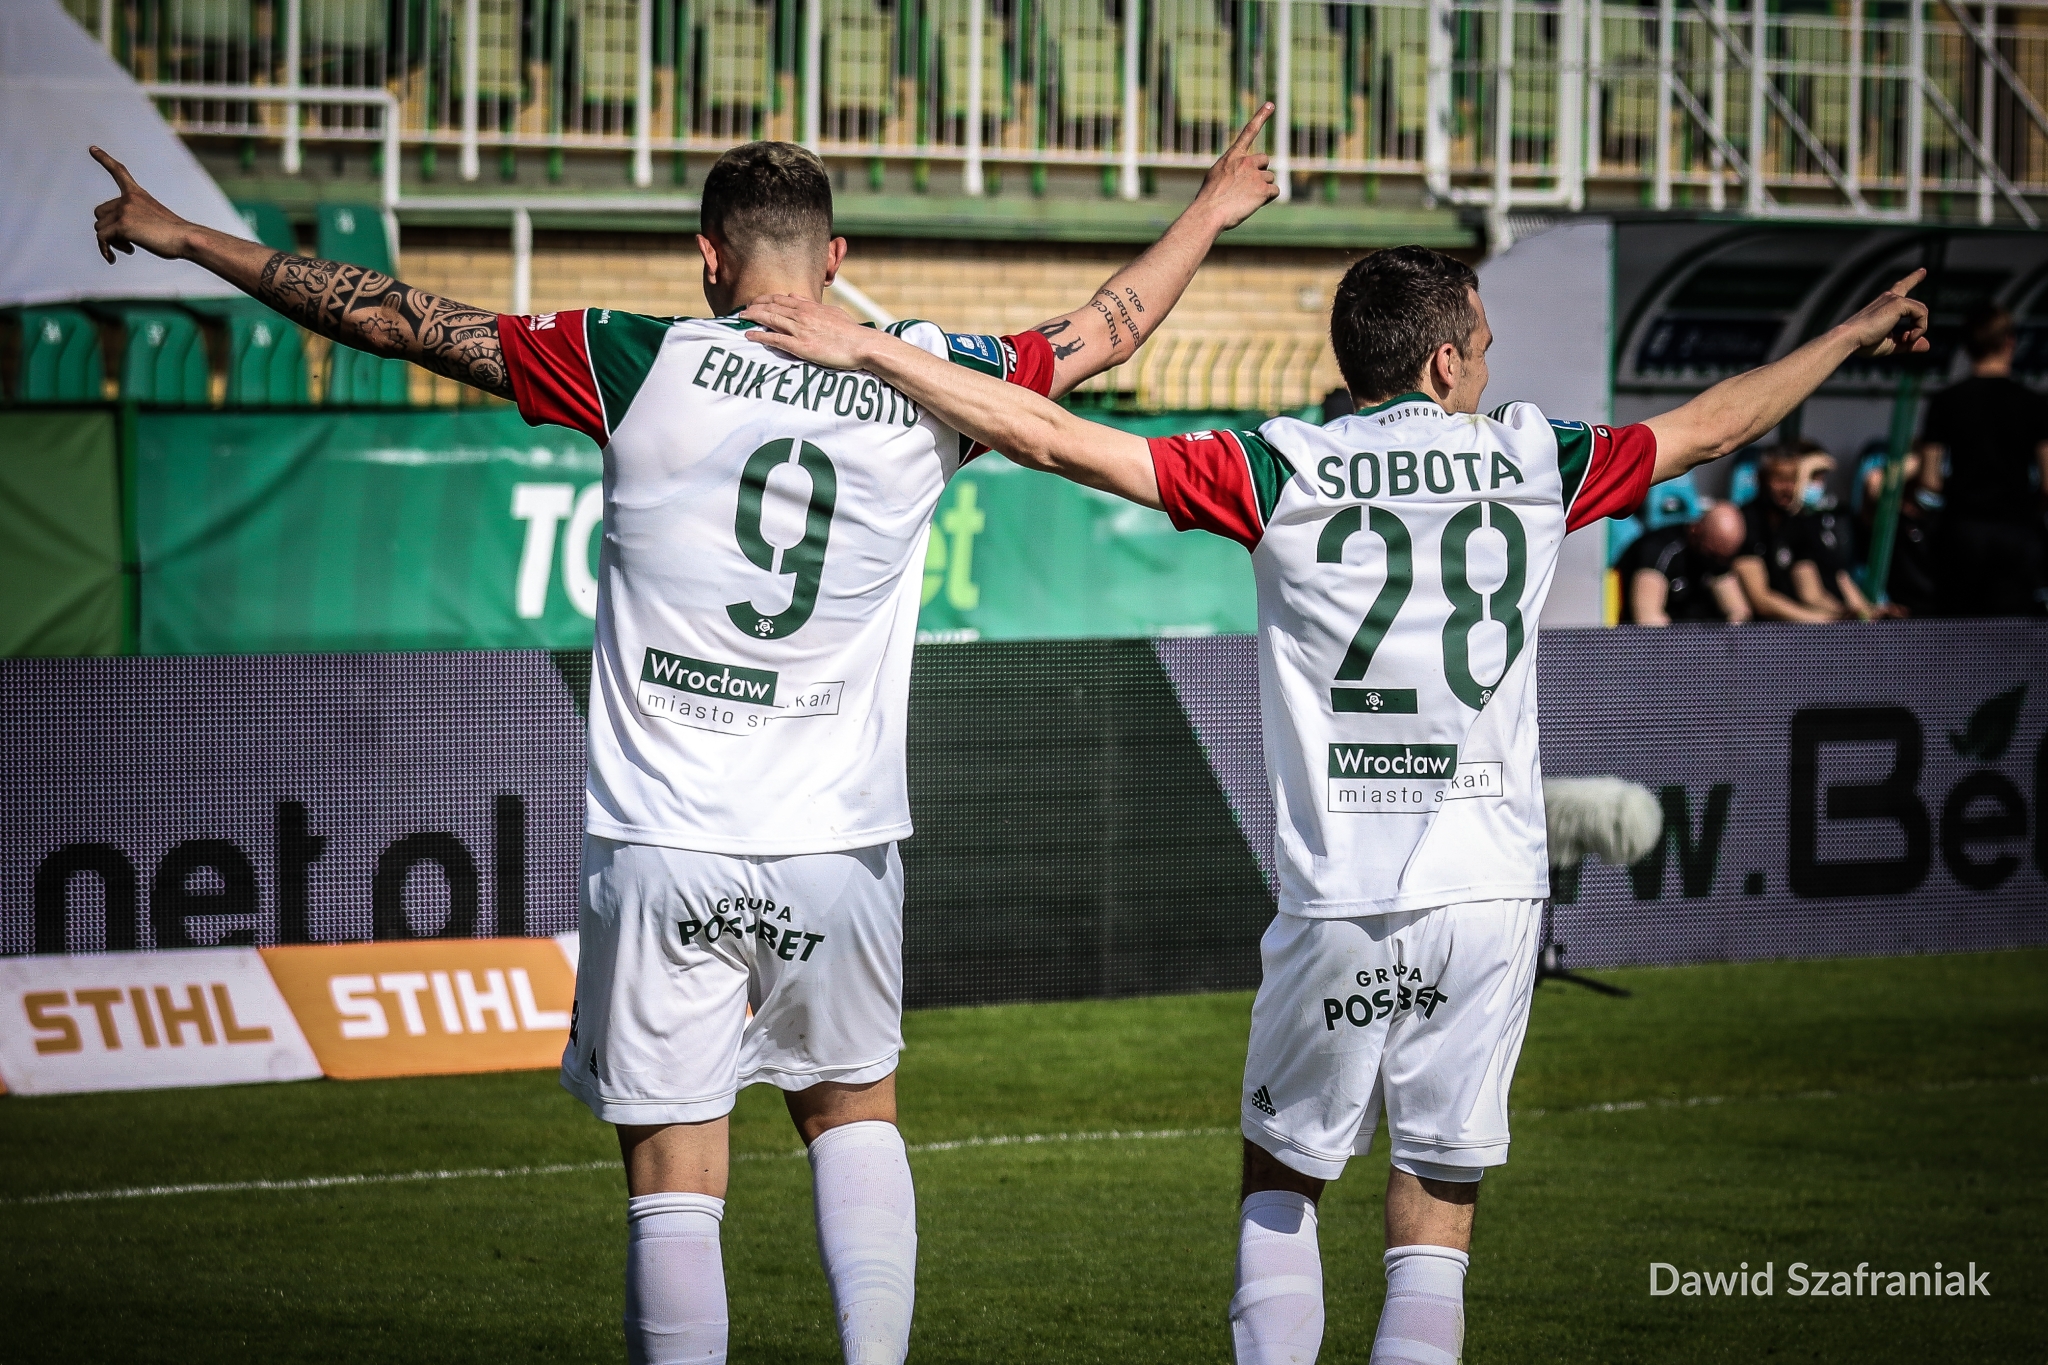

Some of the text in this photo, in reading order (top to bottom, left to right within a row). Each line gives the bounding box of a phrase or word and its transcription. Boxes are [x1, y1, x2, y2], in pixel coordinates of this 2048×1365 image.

[1125, 287, 1145, 313] solo
[1091, 300, 1122, 349] Nunca
[692, 346, 781, 399] ERIK
[1317, 450, 1525, 499] SOBOTA
[725, 437, 838, 641] 9
[1316, 501, 1527, 713] 28
[650, 653, 771, 700] Wrocław
[647, 694, 734, 725] miasto
[1334, 747, 1451, 774] Wrocław
[1339, 786, 1423, 804] miasto
[716, 897, 792, 922] GRUPA
[1356, 962, 1423, 987] GRUPA
[22, 984, 274, 1055] STIHL
[329, 967, 571, 1039] STIHL
[1251, 1097, 1277, 1117] adidas
